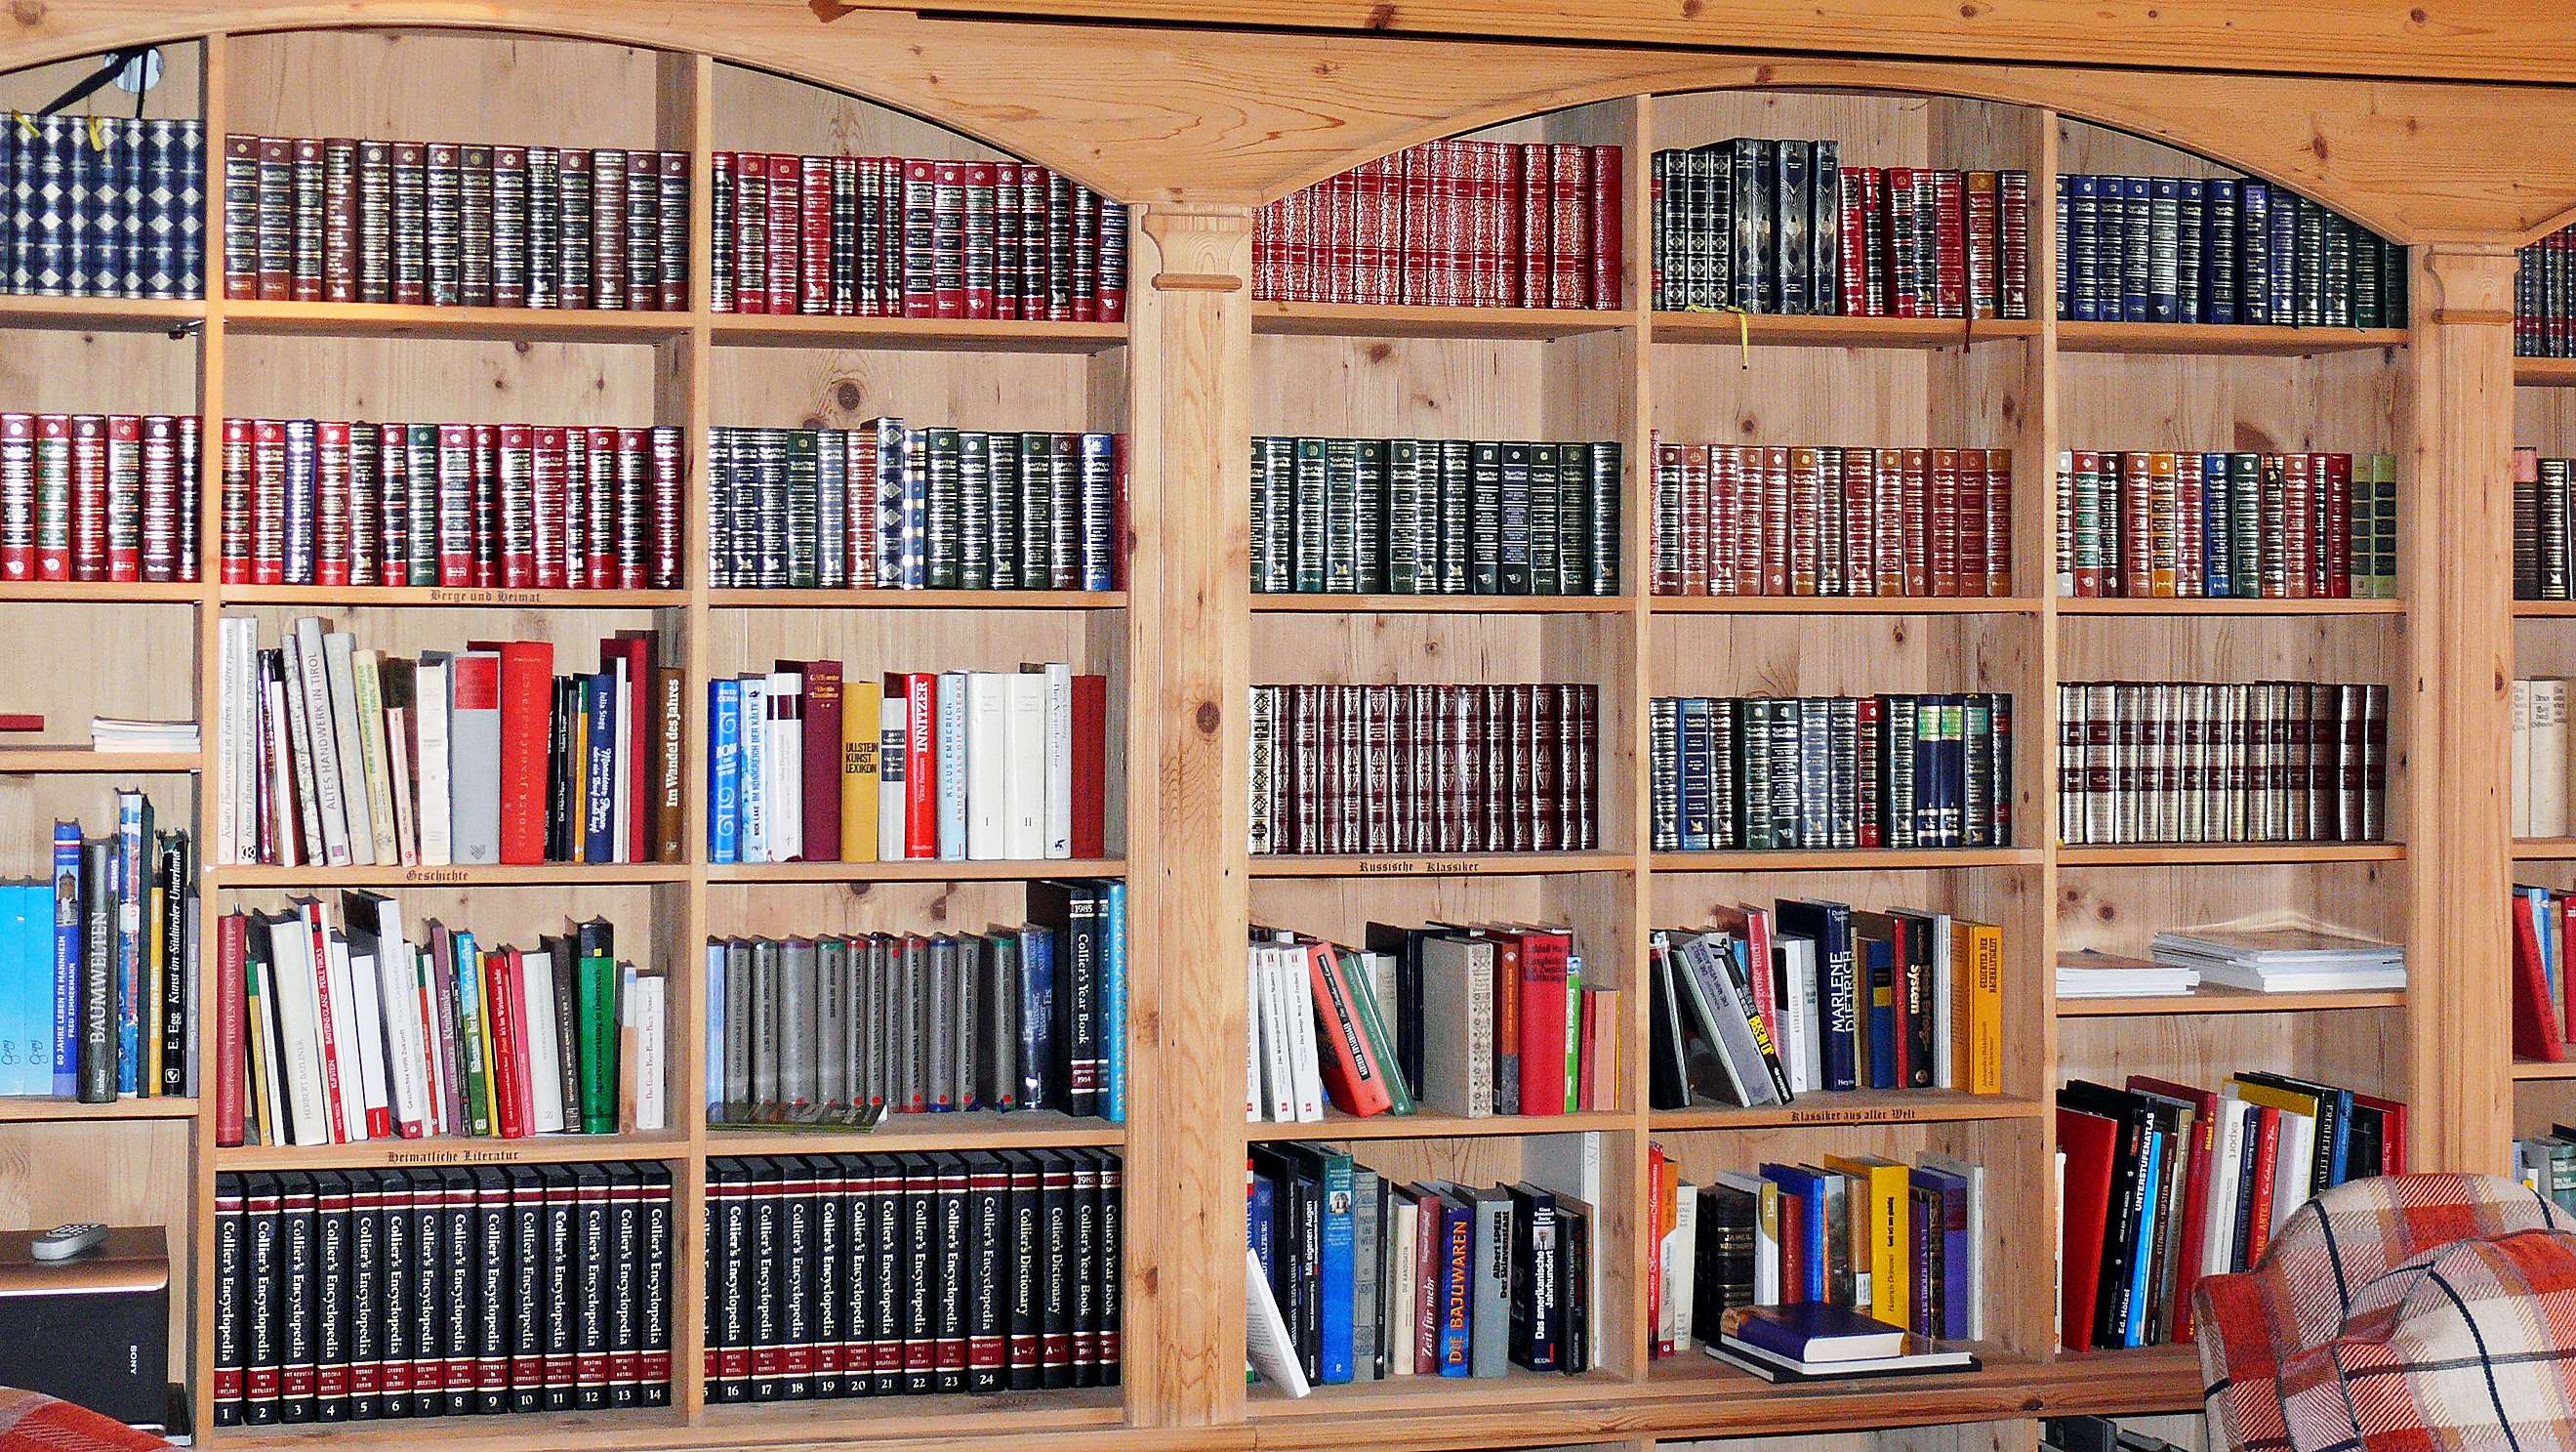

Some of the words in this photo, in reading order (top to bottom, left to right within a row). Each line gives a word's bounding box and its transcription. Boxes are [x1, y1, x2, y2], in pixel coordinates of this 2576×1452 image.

[430, 590, 469, 602] Berge
[470, 591, 493, 602] und
[497, 590, 541, 602] Heimat
[307, 652, 319, 684] TIROL
[312, 688, 321, 701] IN
[598, 692, 608, 709] Julia
[666, 680, 680, 721] Jahres
[597, 711, 607, 730] Stagg
[748, 702, 759, 726] KÄLTE
[916, 681, 928, 753] INNITZER
[316, 704, 331, 773] HANDWERK
[666, 721, 678, 741] des
[749, 726, 759, 743] DER
[845, 742, 879, 752] ULLSTEIN
[665, 742, 678, 789] Wandel
[748, 745, 760, 791] KÖNIGREICH
[845, 753, 872, 763] KUNST
[845, 764, 877, 774] LEXIKON
[325, 777, 337, 810] ALTES
[666, 789, 678, 808] Im
[749, 792, 760, 802] IM
[110, 859, 119, 891] KOSMOS
[168, 850, 182, 900] Unterland
[406, 870, 469, 882] Geschichte
[1359, 861, 1413, 873] Russische
[1425, 861, 1479, 872] Klassiker
[1074, 904, 1093, 913] 1985
[168, 903, 182, 954] Südtiroler
[169, 957, 181, 972] im
[315, 948, 325, 969] TIROLS
[1077, 933, 1089, 982] Collier's
[58, 985, 65, 995] IN
[91, 912, 107, 1044] BAUMWELTEN
[168, 975, 181, 1004] Kunst
[317, 970, 327, 989] PERLE
[1830, 951, 1846, 1033] MARLENE
[1843, 951, 1855, 1032] DIETRICH
[1907, 965, 1921, 1015] System
[57, 998, 65, 1023] LEBEN
[320, 993, 330, 1016] GLANZ
[1077, 984, 1088, 1011] Year
[67, 1018, 76, 1037] FRED
[168, 1013, 182, 1033] Egg
[440, 989, 455, 1040] Kleinhäusler
[1077, 1014, 1088, 1045] Book
[57, 1026, 65, 1054] JAHRE
[168, 1038, 180, 1050] E.
[1761, 1043, 1775, 1056] JO
[57, 1055, 64, 1065] 60
[328, 1060, 338, 1089] KUFSTEIN
[301, 1081, 312, 1120] HERBERT
[1791, 1111, 1840, 1122] Klassiker
[1843, 1111, 1860, 1120] aus
[1863, 1110, 1886, 1120] aller
[1891, 1109, 1915, 1119] Welt
[462, 1149, 519, 1162] Literatur
[2228, 1122, 2238, 1158] export
[2134, 1112, 2155, 1212] UNTERSTUFENATLAS
[793, 1204, 803, 1253] Collier's
[854, 1202, 865, 1251] Collier's
[916, 1200, 926, 1249] Collier's
[984, 1197, 995, 1246] Collier's
[1051, 1207, 1063, 1252] Collier's
[1081, 1205, 1091, 1254] Collier's
[1105, 1205, 1117, 1253] Collier's
[1305, 1200, 1315, 1228] Augen
[1493, 1211, 1502, 1244] SPEER
[294, 1220, 305, 1270] Collier's
[327, 1220, 339, 1270] Collier's
[391, 1216, 402, 1266] Collier's
[455, 1214, 466, 1265] Collier's
[523, 1213, 535, 1263] Collier's
[590, 1211, 600, 1261] Collier's
[651, 1209, 662, 1258] Collier's
[730, 1206, 741, 1257] Collier's
[1020, 1208, 1032, 1253] Collier's
[1305, 1229, 1315, 1261] eigenen
[1500, 1211, 1509, 1278] Sklavenstaat
[224, 1222, 235, 1273] Collier's
[259, 1222, 270, 1272] Collier's
[1492, 1246, 1502, 1279] Albert
[1048, 1254, 1063, 1314] Dictionary
[1081, 1256, 1091, 1281] Year
[1106, 1255, 1116, 1281] Year
[1451, 1221, 1468, 1329] BAJUWAREN
[1544, 1250, 1554, 1308] Jahrhundert
[725, 1260, 740, 1341] Encyclopedia
[789, 1258, 803, 1338] Encyclopedia
[850, 1255, 864, 1335] Encyclopedia
[912, 1254, 925, 1333] Encyclopedia
[980, 1251, 994, 1329] Encyclopedia
[1016, 1255, 1031, 1316] Dictionary
[1081, 1284, 1091, 1315] Book
[1105, 1284, 1117, 1315] Book
[1423, 1276, 1435, 1307] mehr
[1534, 1250, 1545, 1320] amerikanische
[219, 1277, 234, 1361] Encyclopedia
[254, 1277, 269, 1360] Encyclopedia
[289, 1274, 305, 1358] Encyclopedia
[323, 1275, 338, 1357] Encyclopedia
[388, 1271, 402, 1353] Encyclopedia
[451, 1269, 466, 1351] Encyclopedia
[519, 1267, 534, 1348] Encyclopedia
[585, 1265, 598, 1346] Encyclopedia
[647, 1263, 661, 1344] Encyclopedia
[1421, 1309, 1437, 1331] für
[1535, 1321, 1545, 1340] Das
[1421, 1332, 1433, 1357] Zeit
[1449, 1335, 1463, 1363] DIE
[650, 1390, 661, 1399] 14
[728, 1386, 739, 1395] 16
[792, 1383, 803, 1392] 18
[852, 1381, 865, 1390] 20
[913, 1379, 925, 1388] 22
[980, 1375, 993, 1384] 24
[260, 1408, 266, 1418] 2
[295, 1405, 302, 1415] 3
[327, 1405, 335, 1416] 4
[392, 1401, 399, 1411] 6
[455, 1397, 462, 1407] 8
[521, 1395, 532, 1405] 10
[586, 1392, 598, 1402] 12
[223, 1409, 228, 1419] 1
